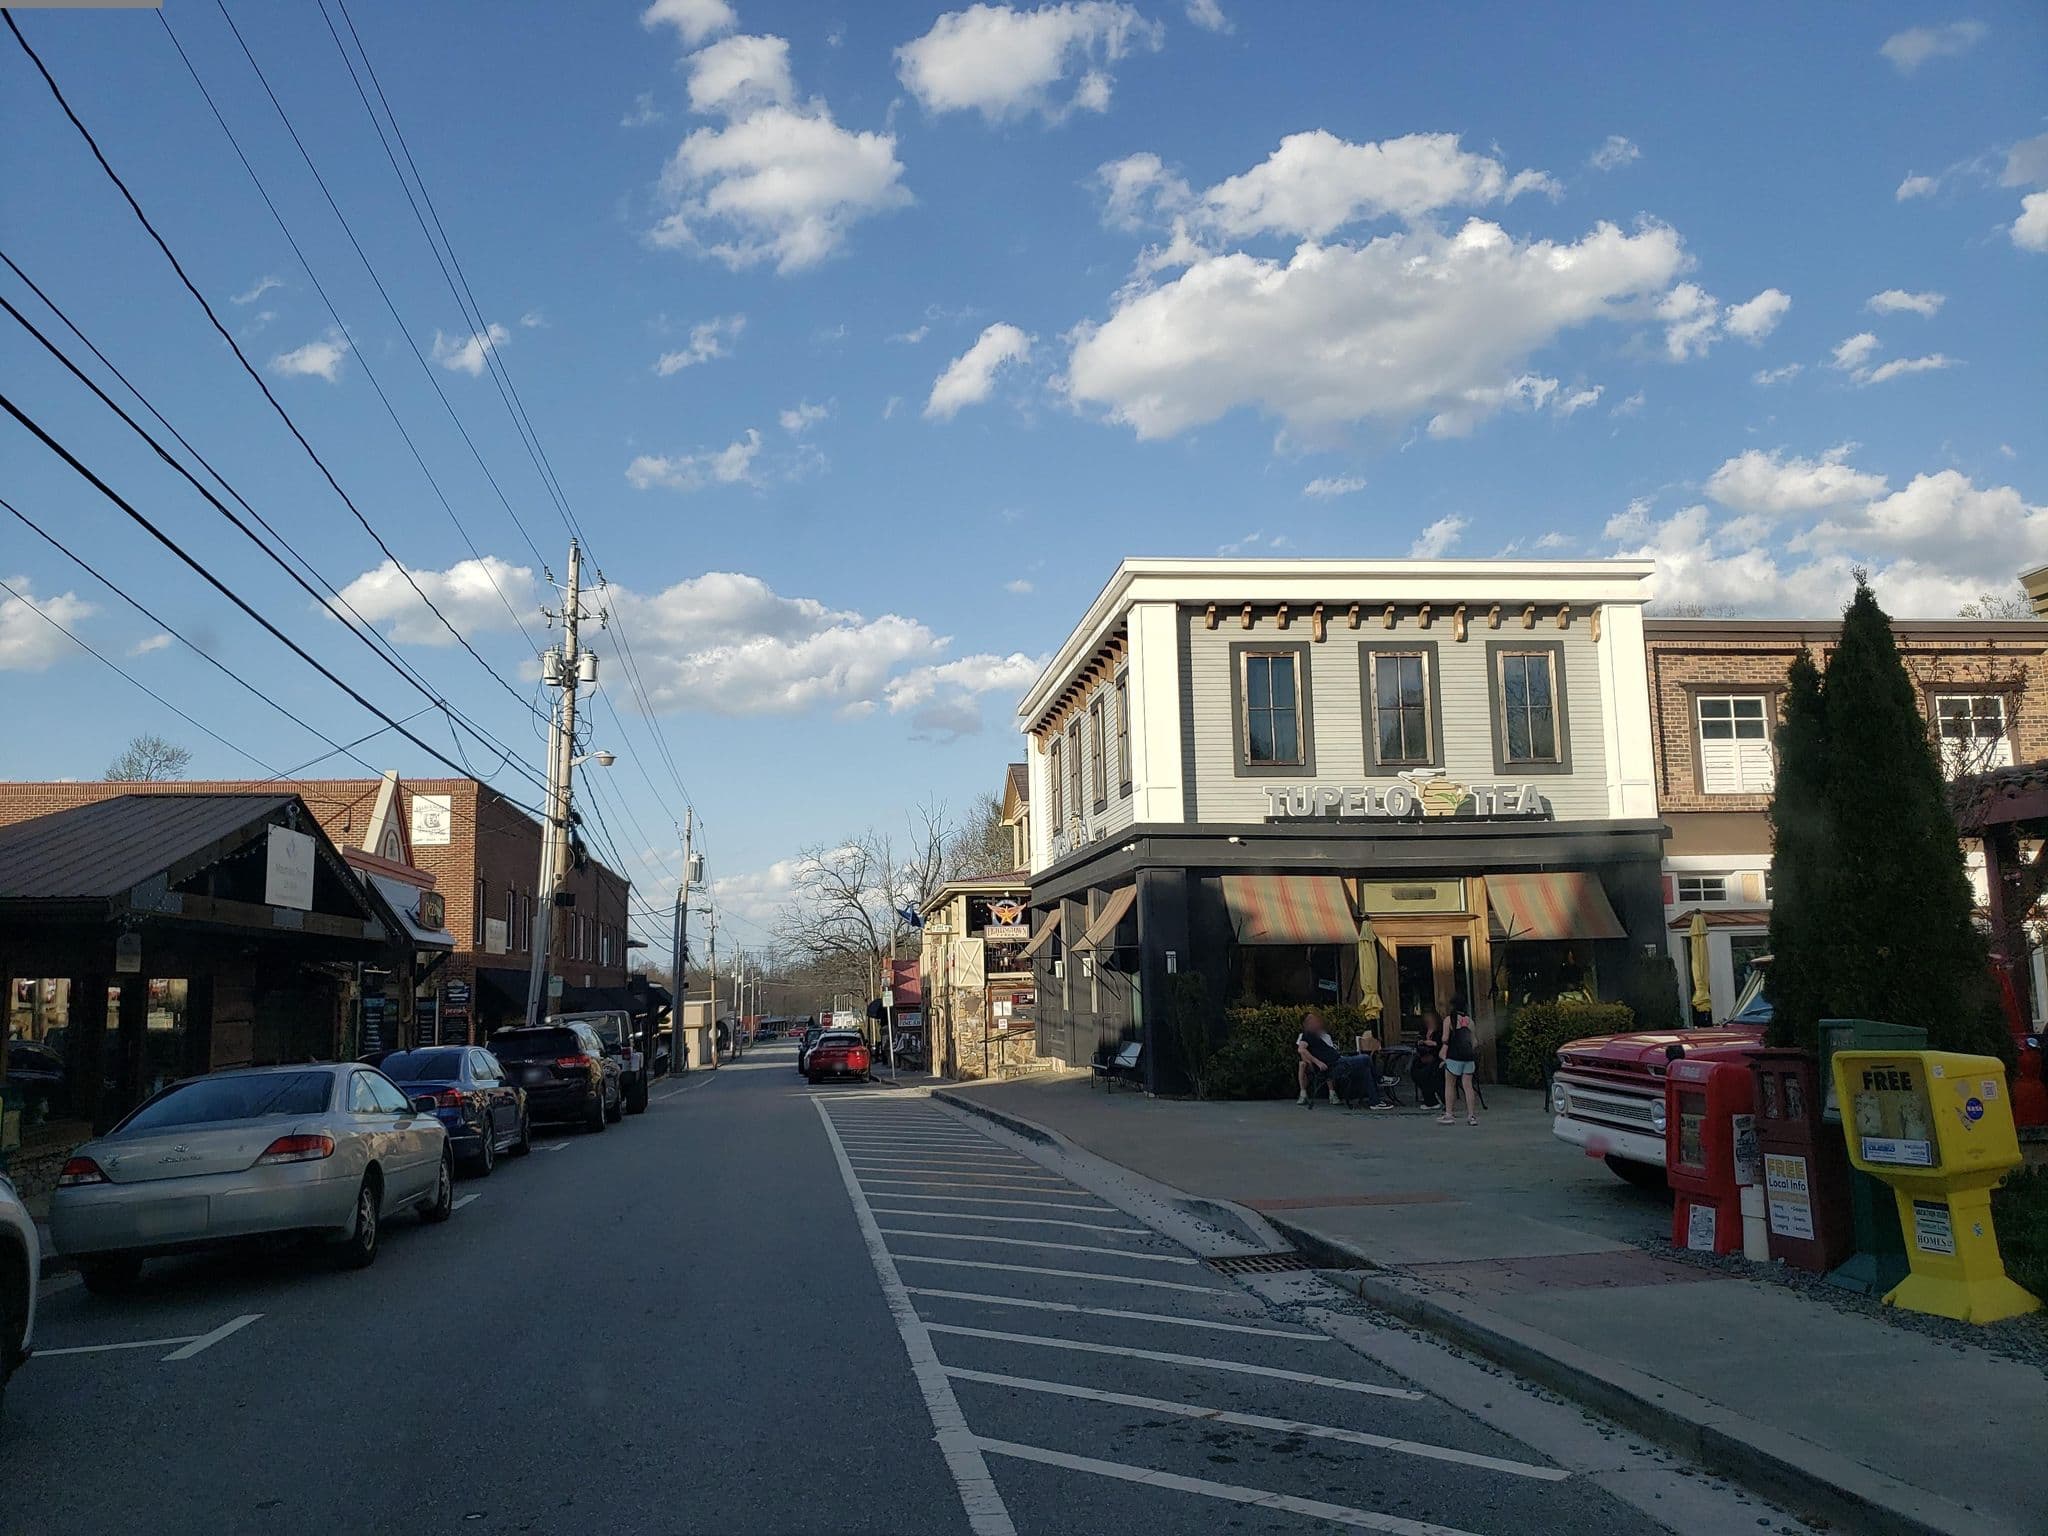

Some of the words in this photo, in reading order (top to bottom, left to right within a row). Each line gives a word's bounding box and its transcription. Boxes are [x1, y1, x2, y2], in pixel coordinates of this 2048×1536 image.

[1263, 785, 1413, 816] TUPELO
[1470, 784, 1545, 815] TEA
[1863, 1071, 1912, 1091] FREE
[1966, 1104, 1983, 1112] NASA
[1767, 1158, 1805, 1180] FREE
[1769, 1177, 1789, 1188] Local
[1790, 1179, 1806, 1191] Info
